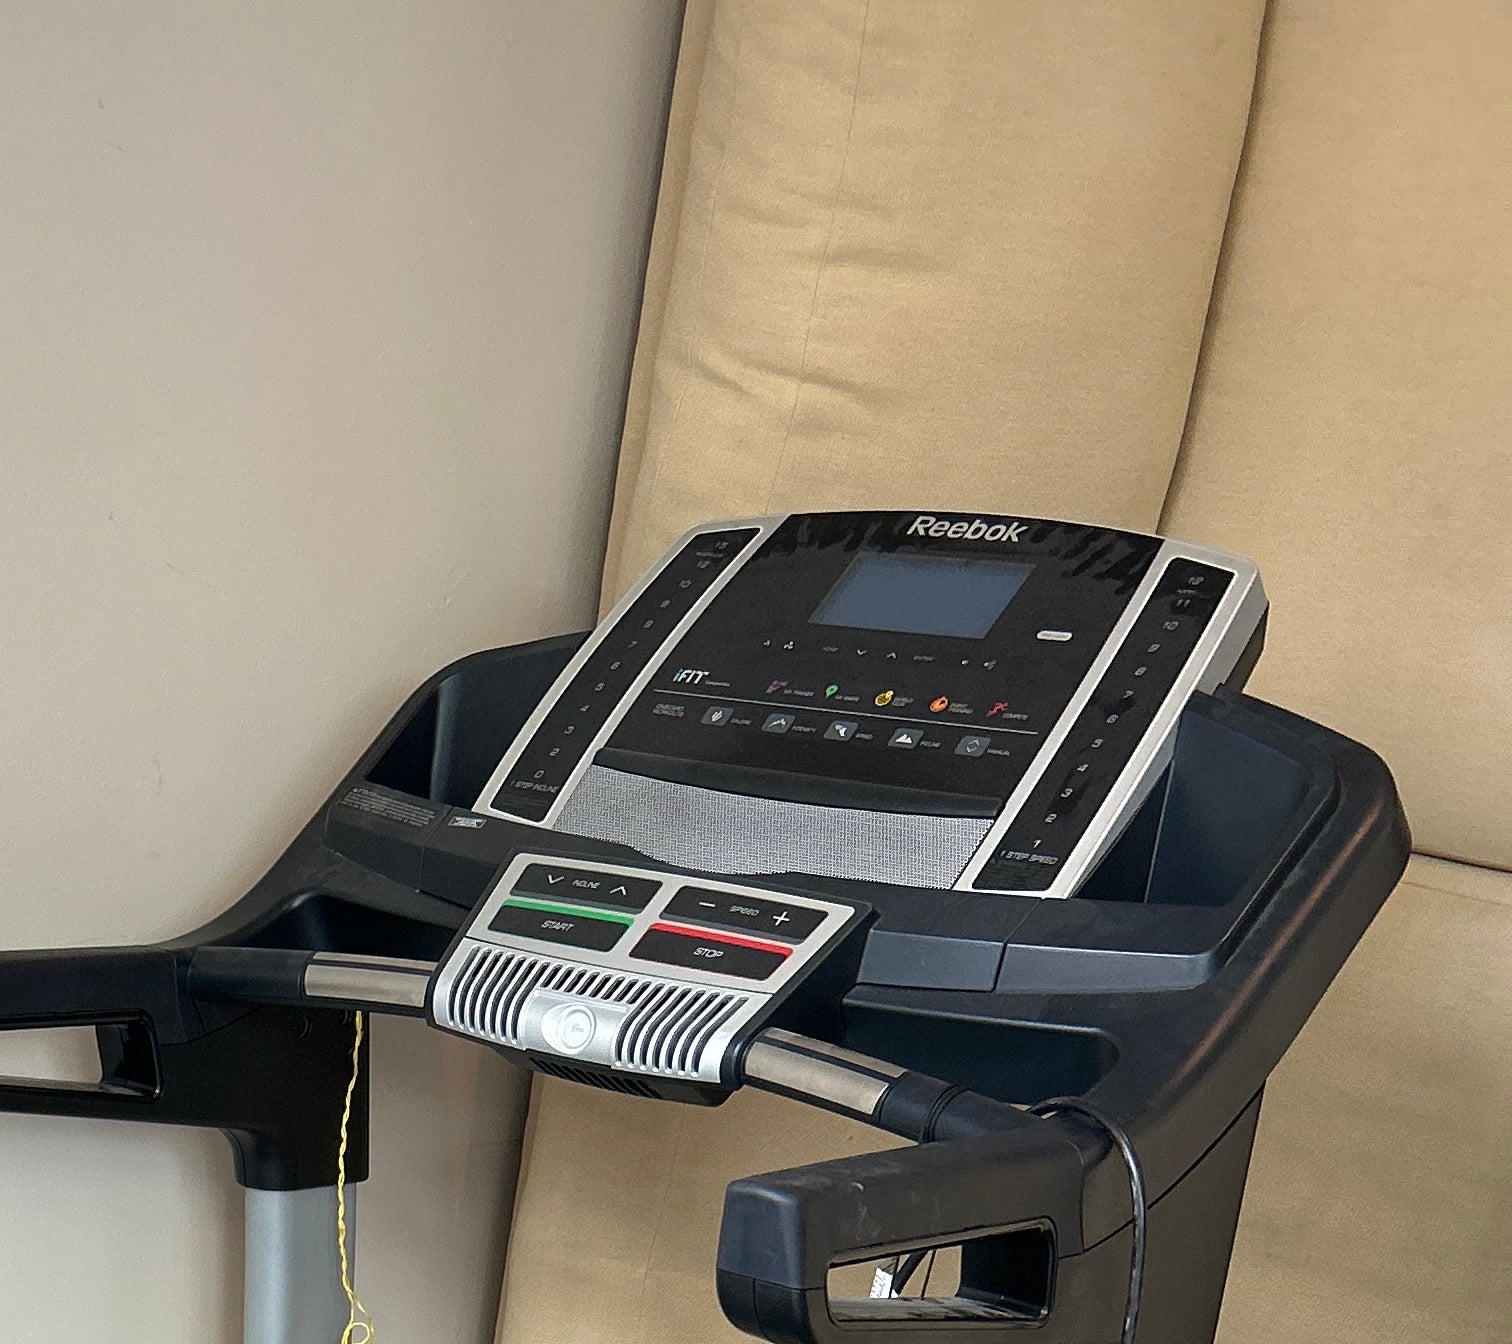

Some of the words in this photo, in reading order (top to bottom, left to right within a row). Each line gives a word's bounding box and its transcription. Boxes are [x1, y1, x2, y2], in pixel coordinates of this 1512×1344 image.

[906, 515, 1029, 543] Reebok
[1122, 690, 1134, 699] 7
[1106, 714, 1119, 724] 6
[563, 725, 575, 735] 3
[1091, 738, 1104, 749] 5
[549, 747, 561, 757] 2
[1076, 763, 1089, 773] 4
[533, 769, 545, 779] 0
[1060, 787, 1073, 798] 3
[1044, 813, 1057, 823] 2
[1033, 839, 1042, 849] 1
[1006, 851, 1030, 862] STEP
[1028, 853, 1059, 866] SPEED
[728, 904, 760, 917] SPEED
[540, 919, 575, 933] START
[693, 947, 724, 959] STOP
